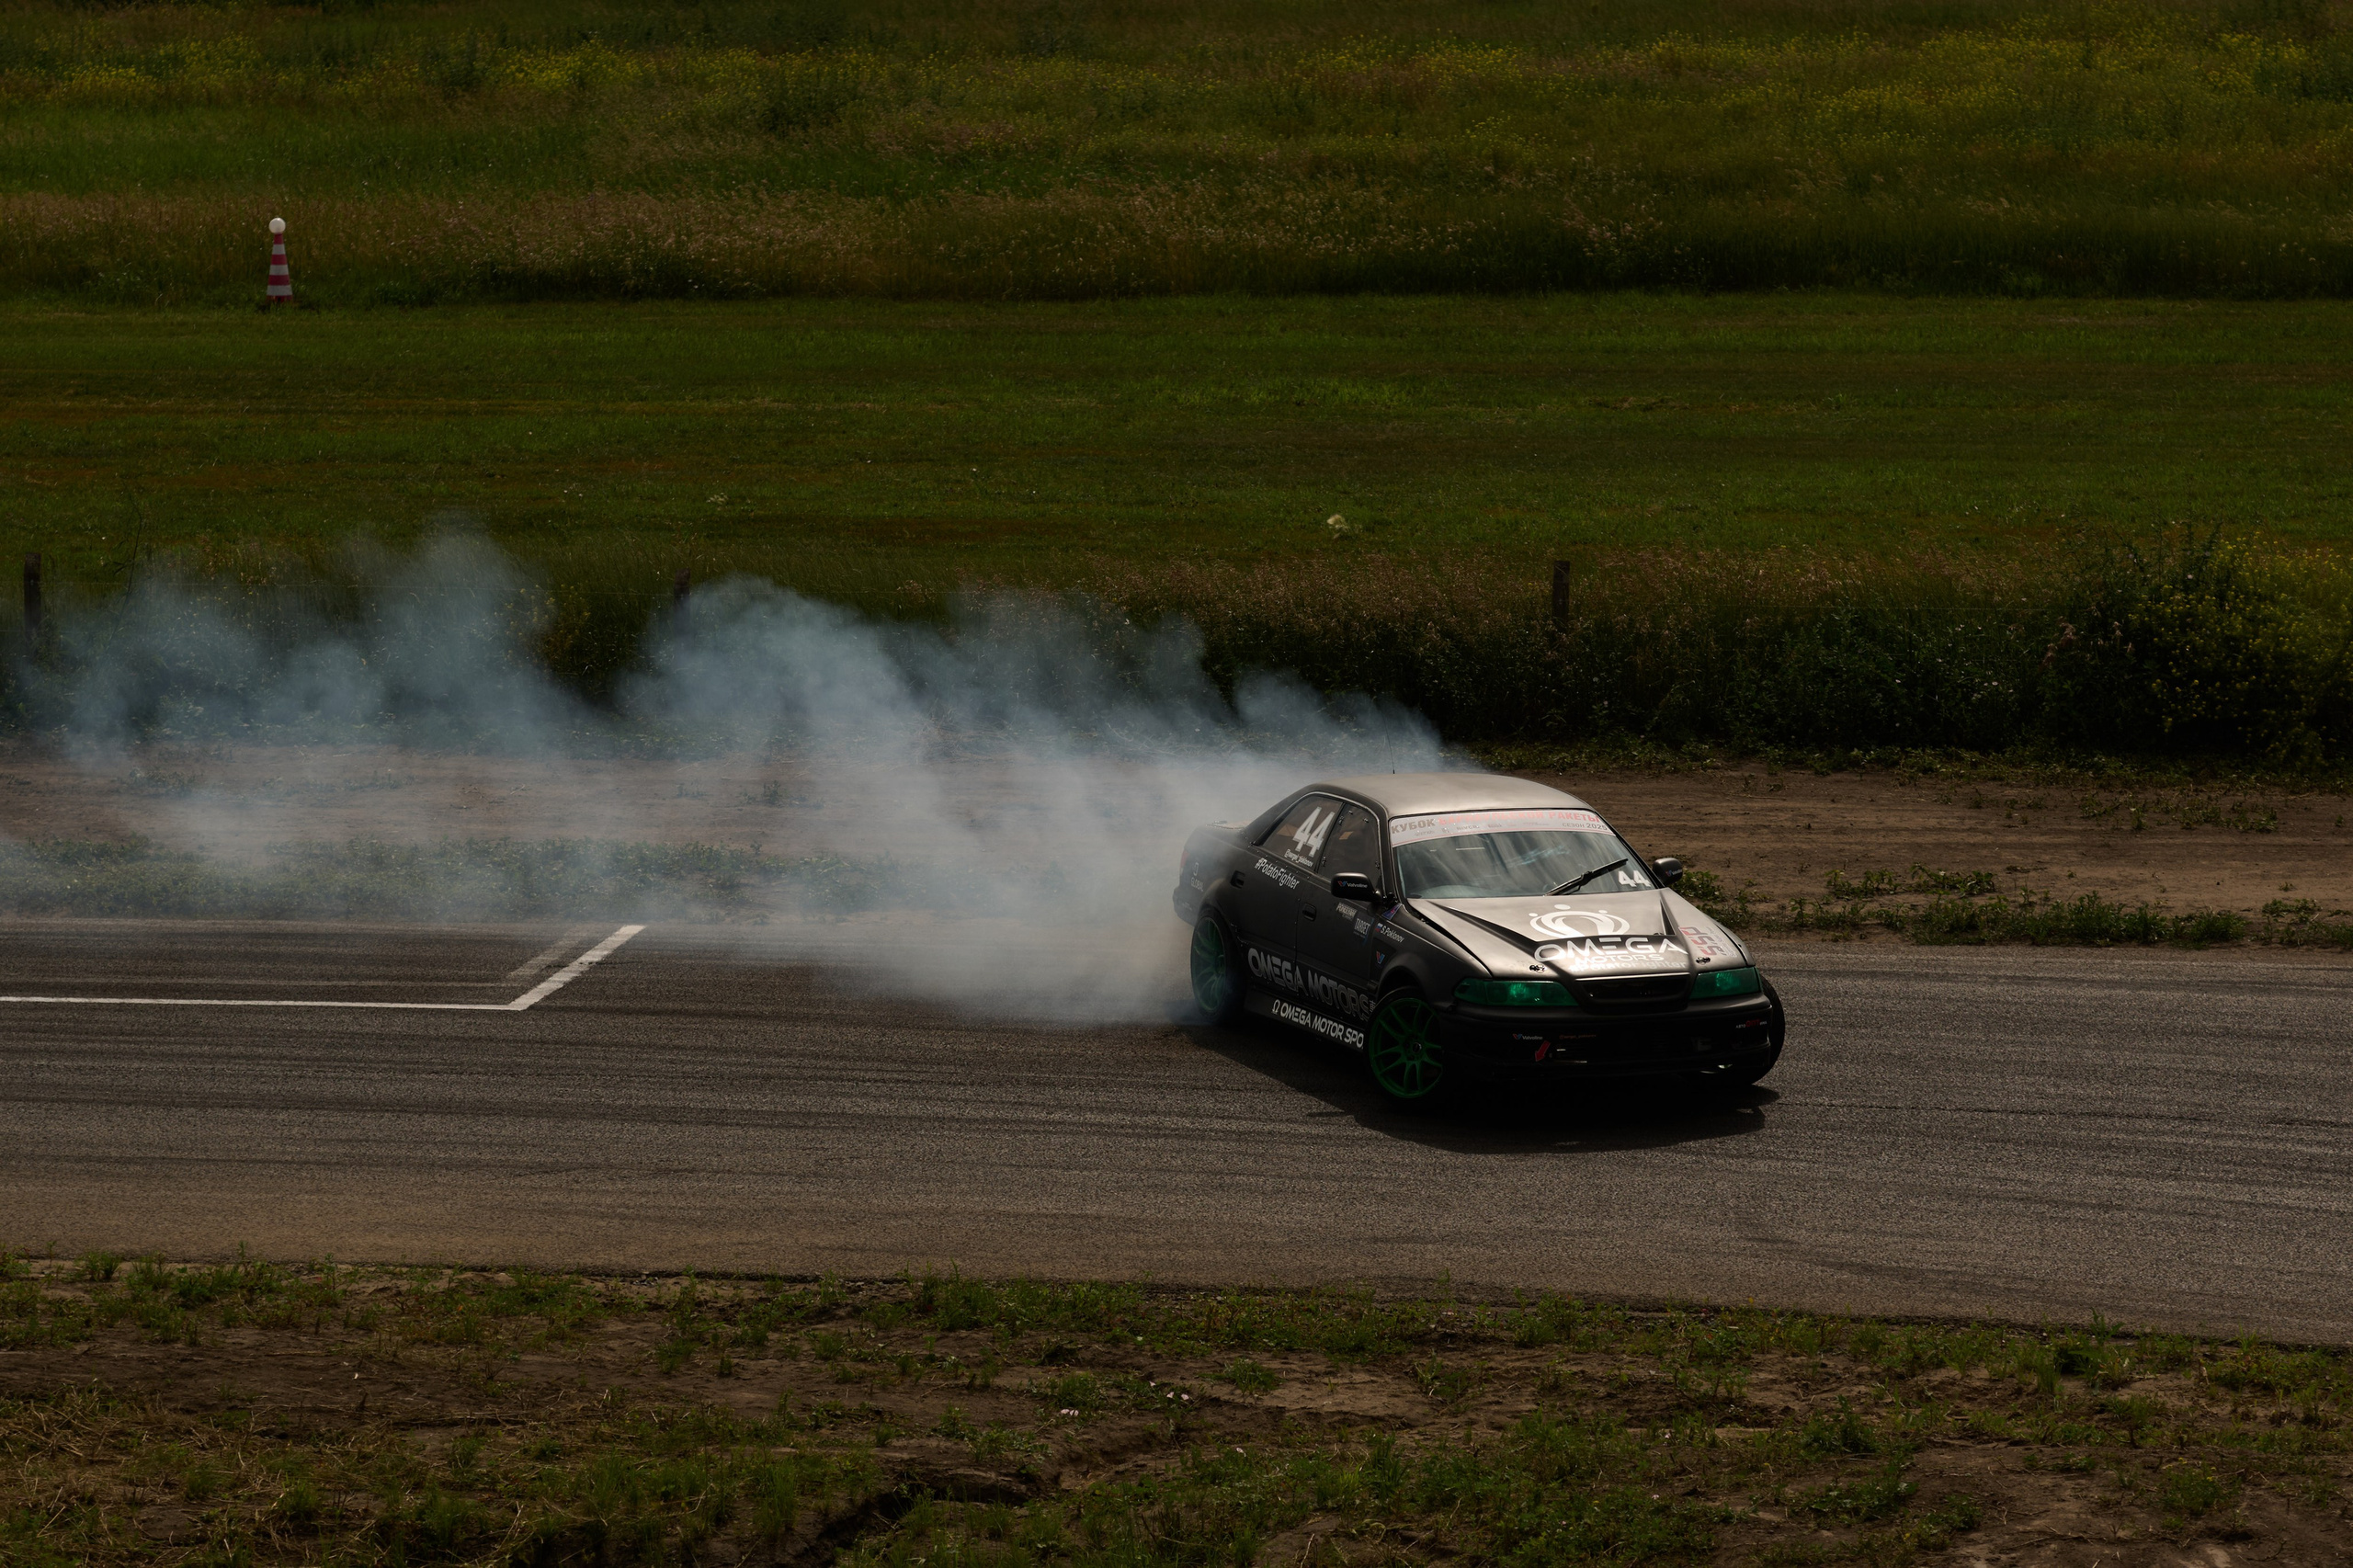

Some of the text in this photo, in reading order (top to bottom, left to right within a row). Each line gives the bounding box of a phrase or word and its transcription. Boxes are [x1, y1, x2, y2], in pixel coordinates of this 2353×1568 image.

[1292, 806, 1335, 858] 44
[1391, 818, 1436, 834] КУБОК
[1549, 812, 1600, 823] РАКЕТЫ
[1254, 858, 1301, 890] #PotatoFighter
[1618, 869, 1651, 888] 44
[1533, 937, 1688, 962] OMEGA
[1574, 954, 1665, 966] MOTORS
[1247, 948, 1370, 1022] OMEGA MOTORS
[1280, 1002, 1365, 1050] OMEGA MOTOR SPO
